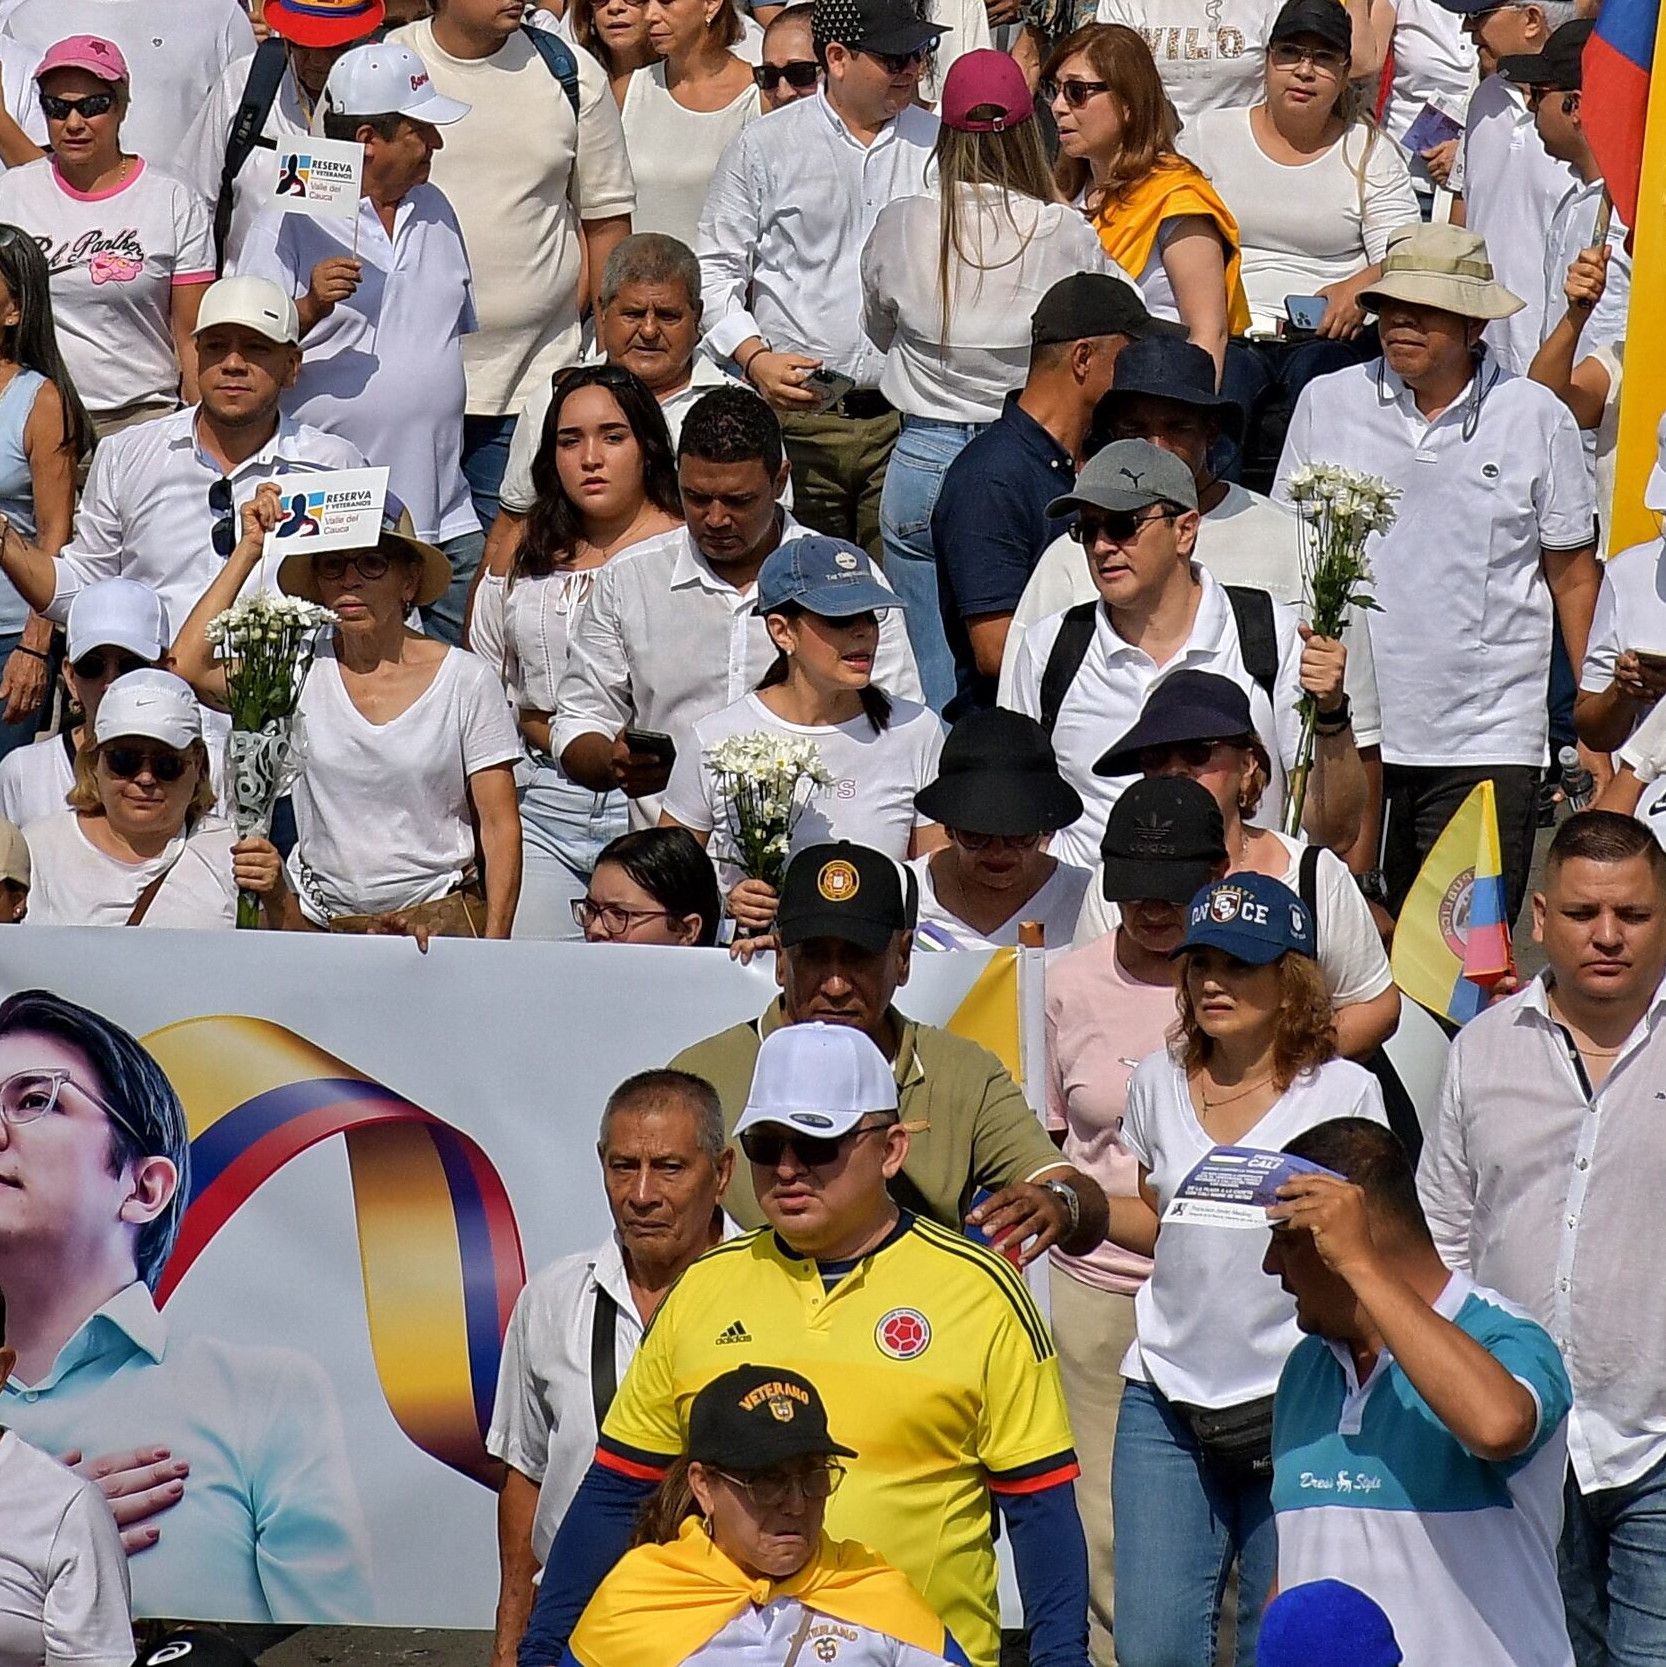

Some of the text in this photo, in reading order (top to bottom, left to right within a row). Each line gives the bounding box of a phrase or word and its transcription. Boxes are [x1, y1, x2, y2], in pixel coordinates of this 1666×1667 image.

[312, 159, 353, 173] RESERVA
[317, 168, 351, 181] VETERANOS
[310, 180, 342, 193] Valle del
[310, 190, 333, 202] Cauca
[73, 229, 144, 260] Panther
[326, 490, 373, 503] RESERVA
[332, 499, 372, 510] VETERANOS
[324, 513, 359, 526] Valle del
[323, 524, 350, 536] Cauca
[1248, 1159, 1281, 1169] CALI
[715, 1334, 751, 1345] adidas
[738, 1381, 808, 1412] VETERANO
[1300, 1472, 1381, 1493] Dress Style
